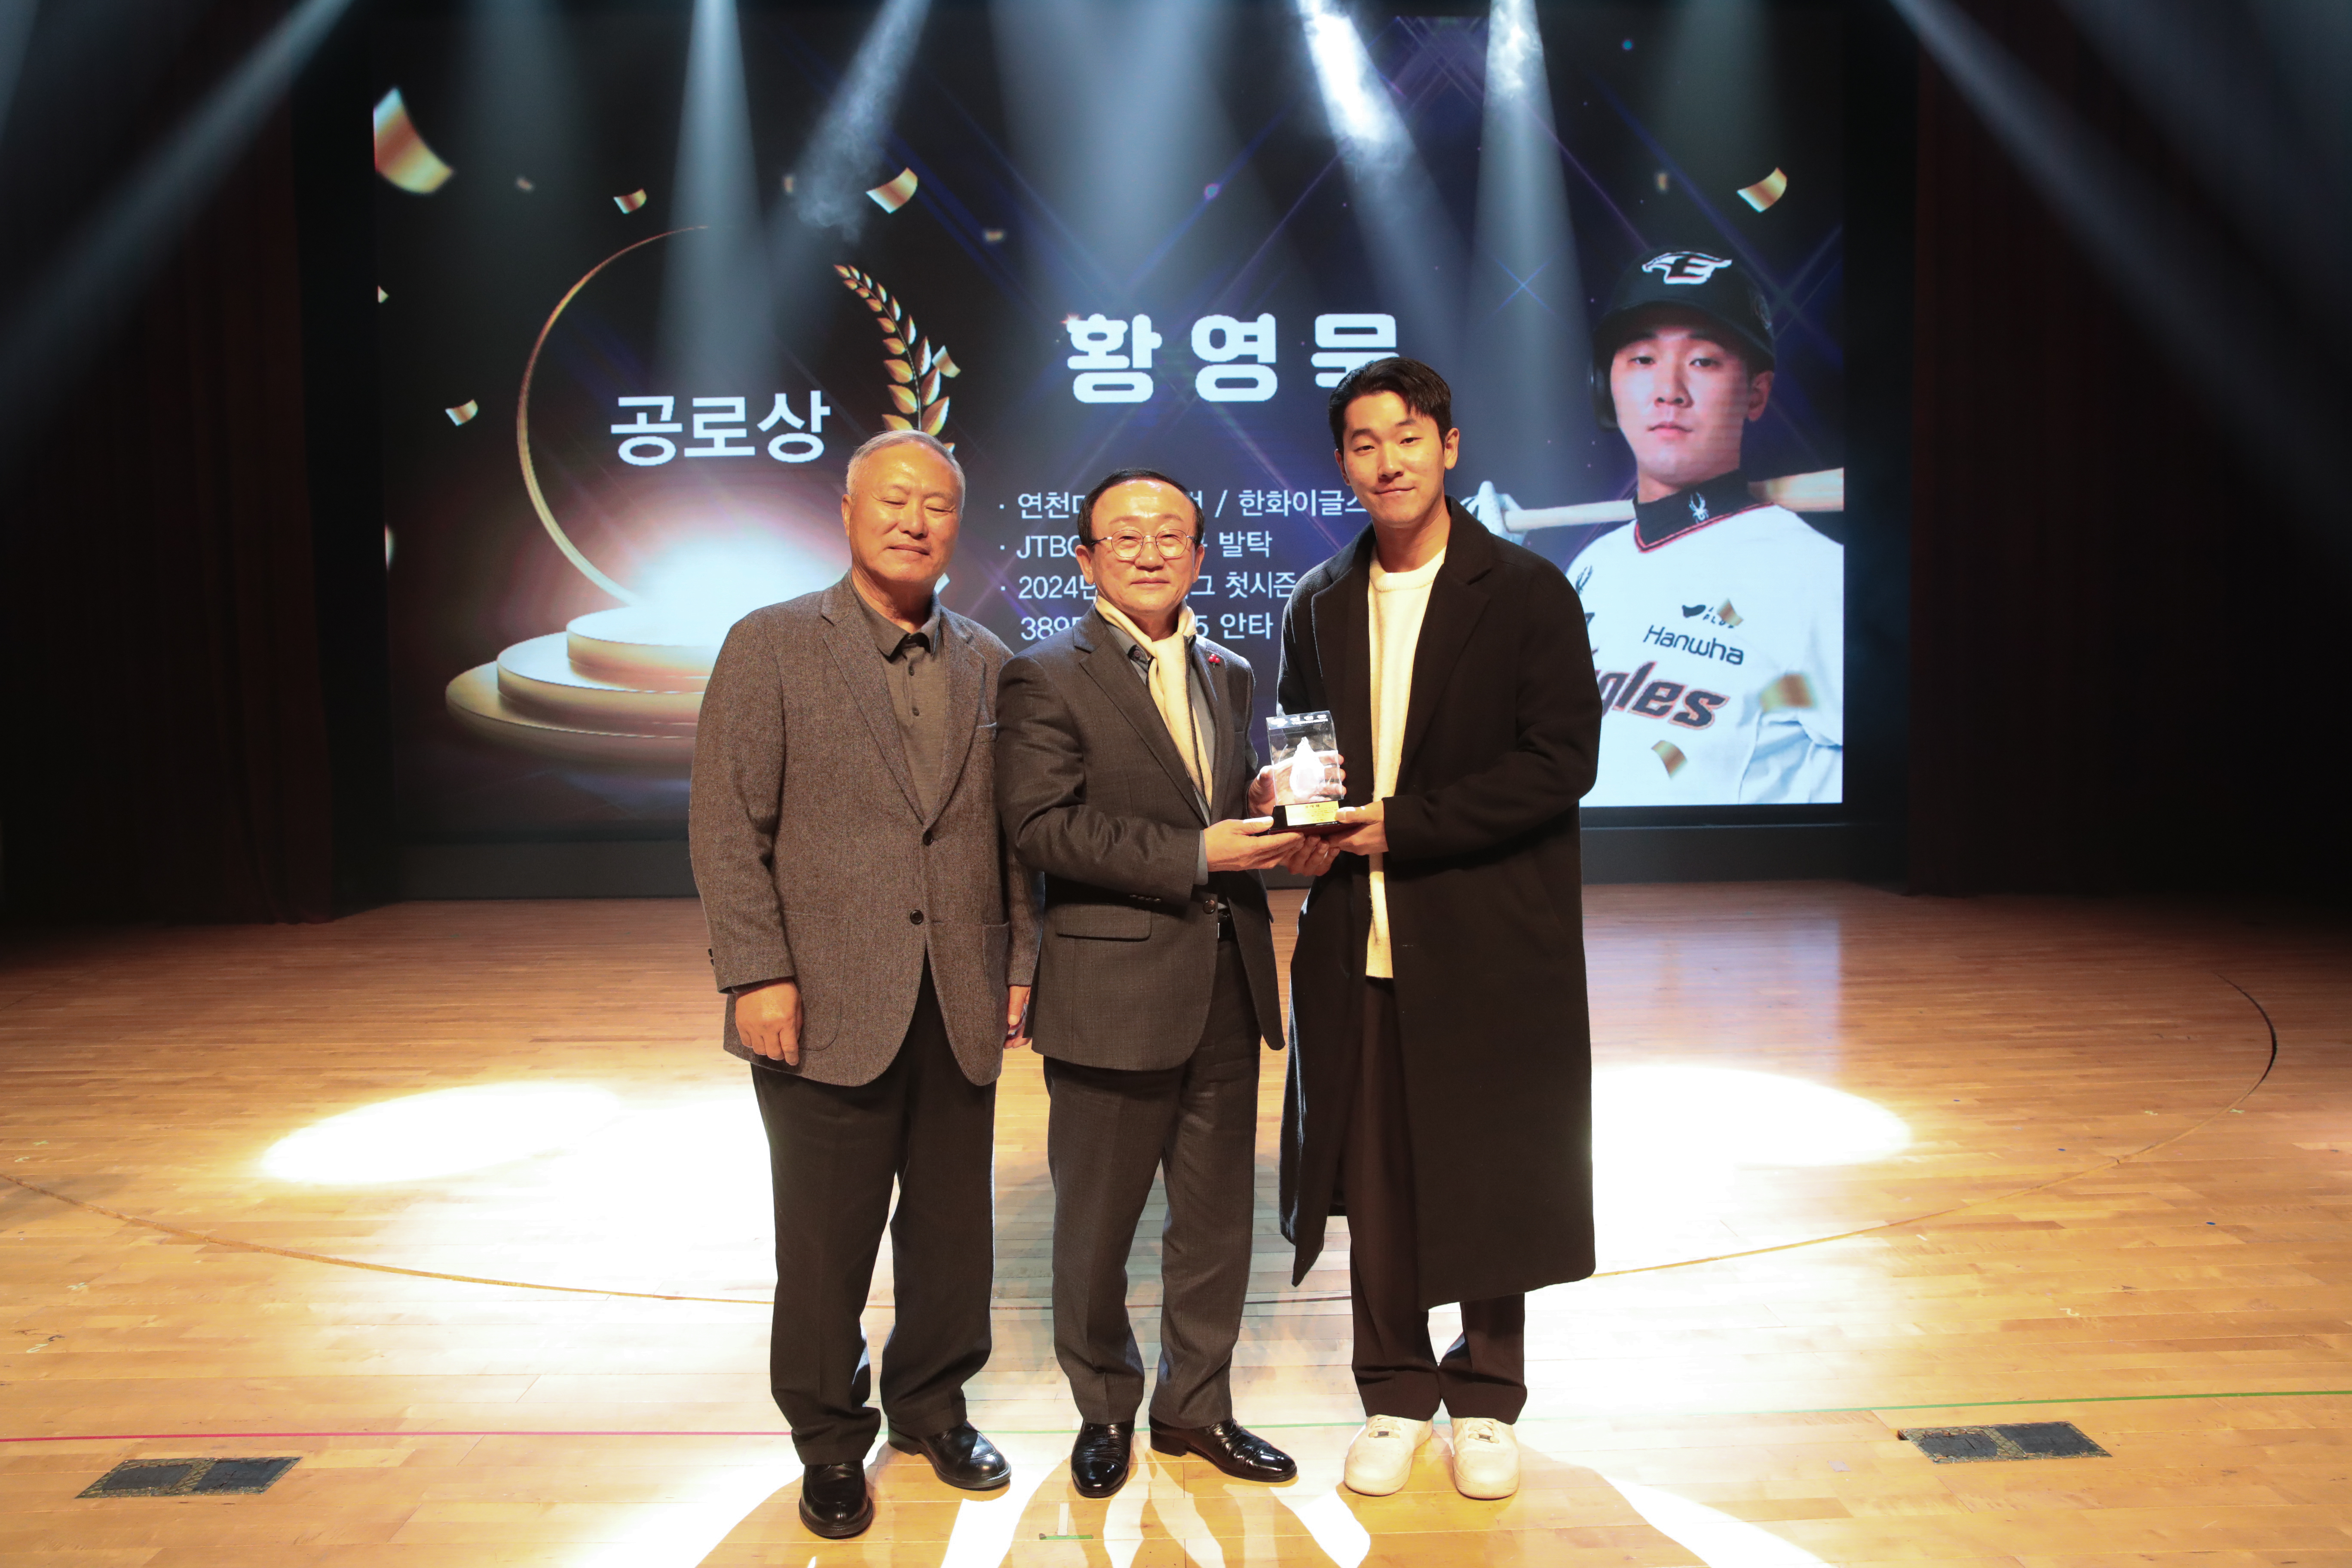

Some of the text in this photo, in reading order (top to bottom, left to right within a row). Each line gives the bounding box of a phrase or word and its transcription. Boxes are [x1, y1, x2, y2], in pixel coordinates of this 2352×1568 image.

[1067, 313, 1163, 404] 황
[1191, 313, 1278, 402] 영
[611, 390, 830, 466] 공로상
[1219, 530, 1273, 557] 발탁
[1225, 571, 1296, 599] 첫시즌
[1021, 616, 1082, 640] 389
[1220, 612, 1274, 640] 안타
[1643, 625, 1744, 665] Hanwha
[1595, 661, 1730, 730] gles
